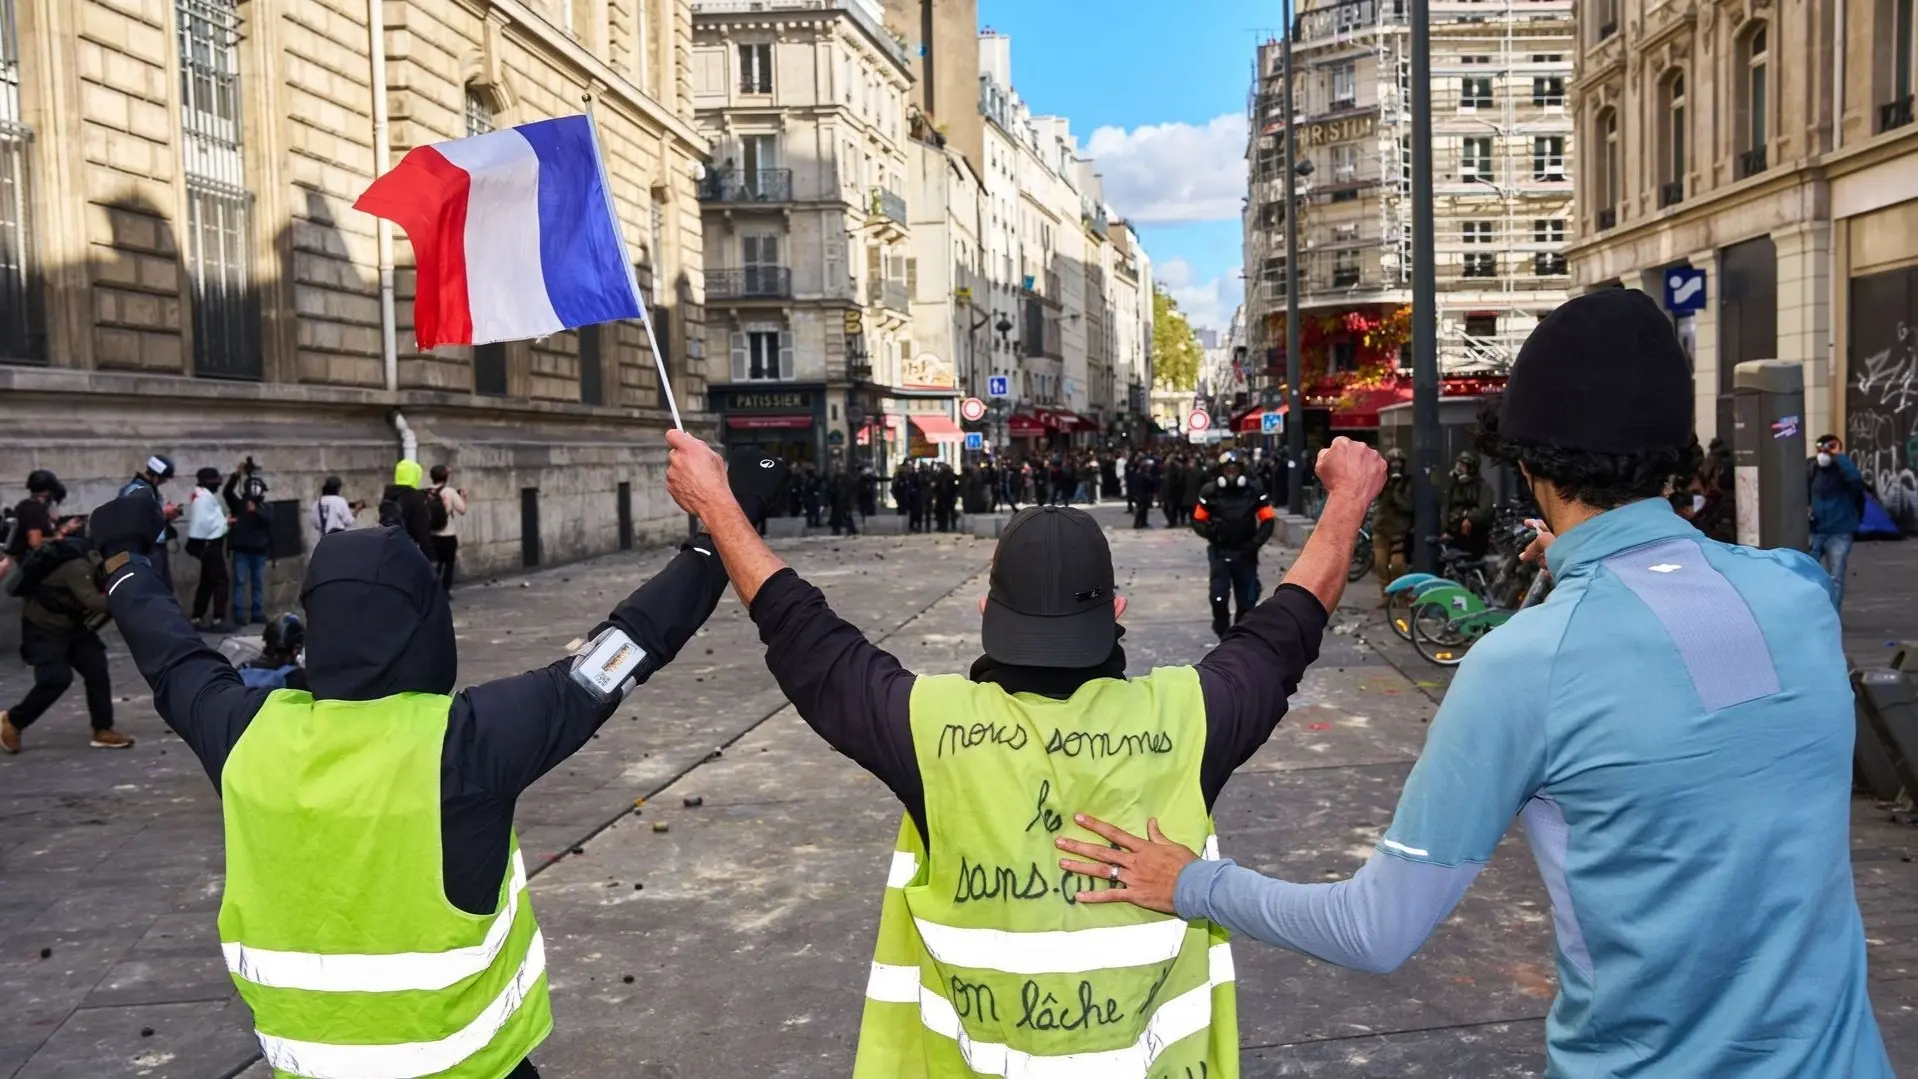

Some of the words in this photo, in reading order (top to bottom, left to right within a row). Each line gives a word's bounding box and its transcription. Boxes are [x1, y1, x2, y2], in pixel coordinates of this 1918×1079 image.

[736, 394, 803, 408] PATISSIER
[938, 722, 1028, 758] nous
[1046, 727, 1173, 760] sommes
[1025, 779, 1063, 833] les
[951, 974, 1000, 1023] on
[1016, 979, 1125, 1031] lâche
